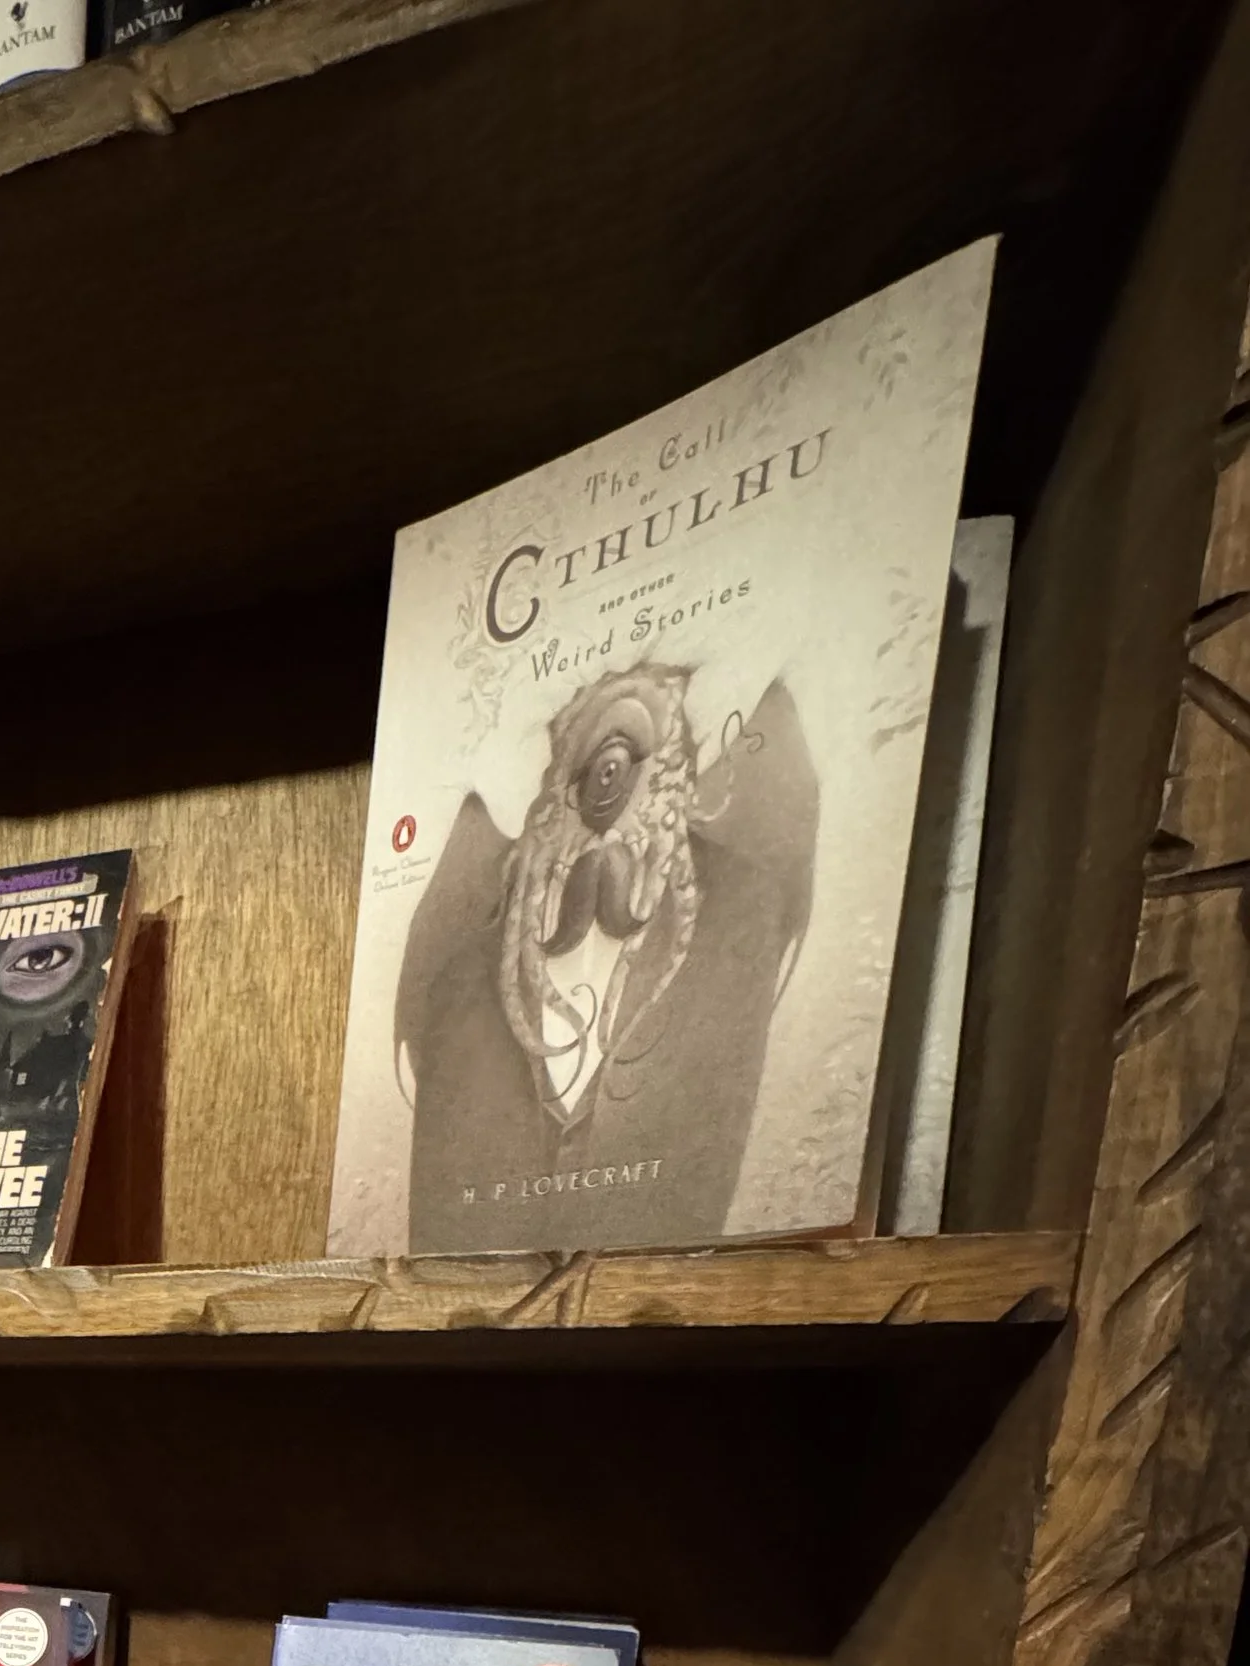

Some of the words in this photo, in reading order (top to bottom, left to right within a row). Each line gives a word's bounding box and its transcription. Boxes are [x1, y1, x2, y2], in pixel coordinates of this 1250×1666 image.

[114, 4, 184, 45] BANTAM
[583, 469, 640, 505] The
[659, 416, 726, 472] Call
[486, 427, 832, 644] CTHULHU
[532, 637, 614, 683] Weird
[630, 577, 751, 642] Stories
[521, 1159, 664, 1198] LOVECRAFT
